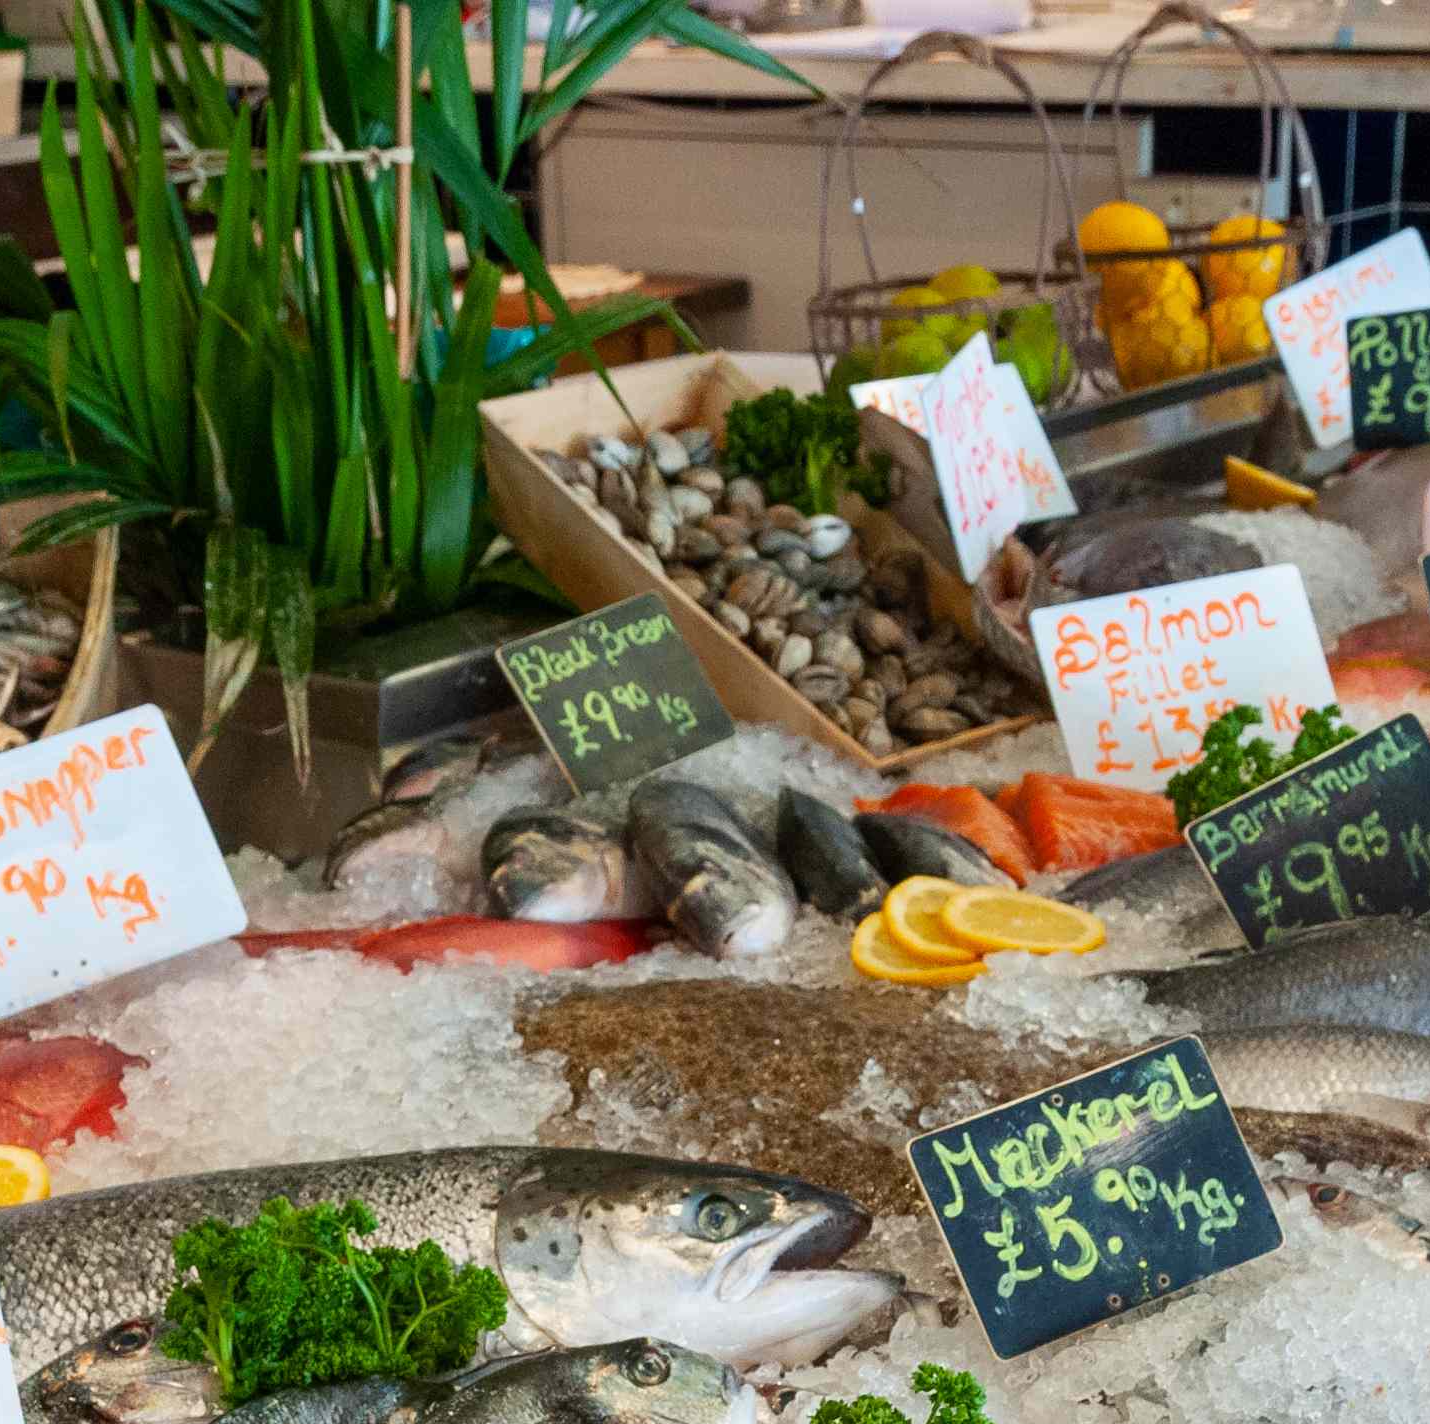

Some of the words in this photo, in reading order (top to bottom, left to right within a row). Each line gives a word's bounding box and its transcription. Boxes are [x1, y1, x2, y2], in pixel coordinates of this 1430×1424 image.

[508, 637, 599, 703] Black
[1053, 591, 1277, 691] Salmon
[1104, 656, 1228, 716] Fillet
[931, 1053, 1220, 1219] Mackerel
